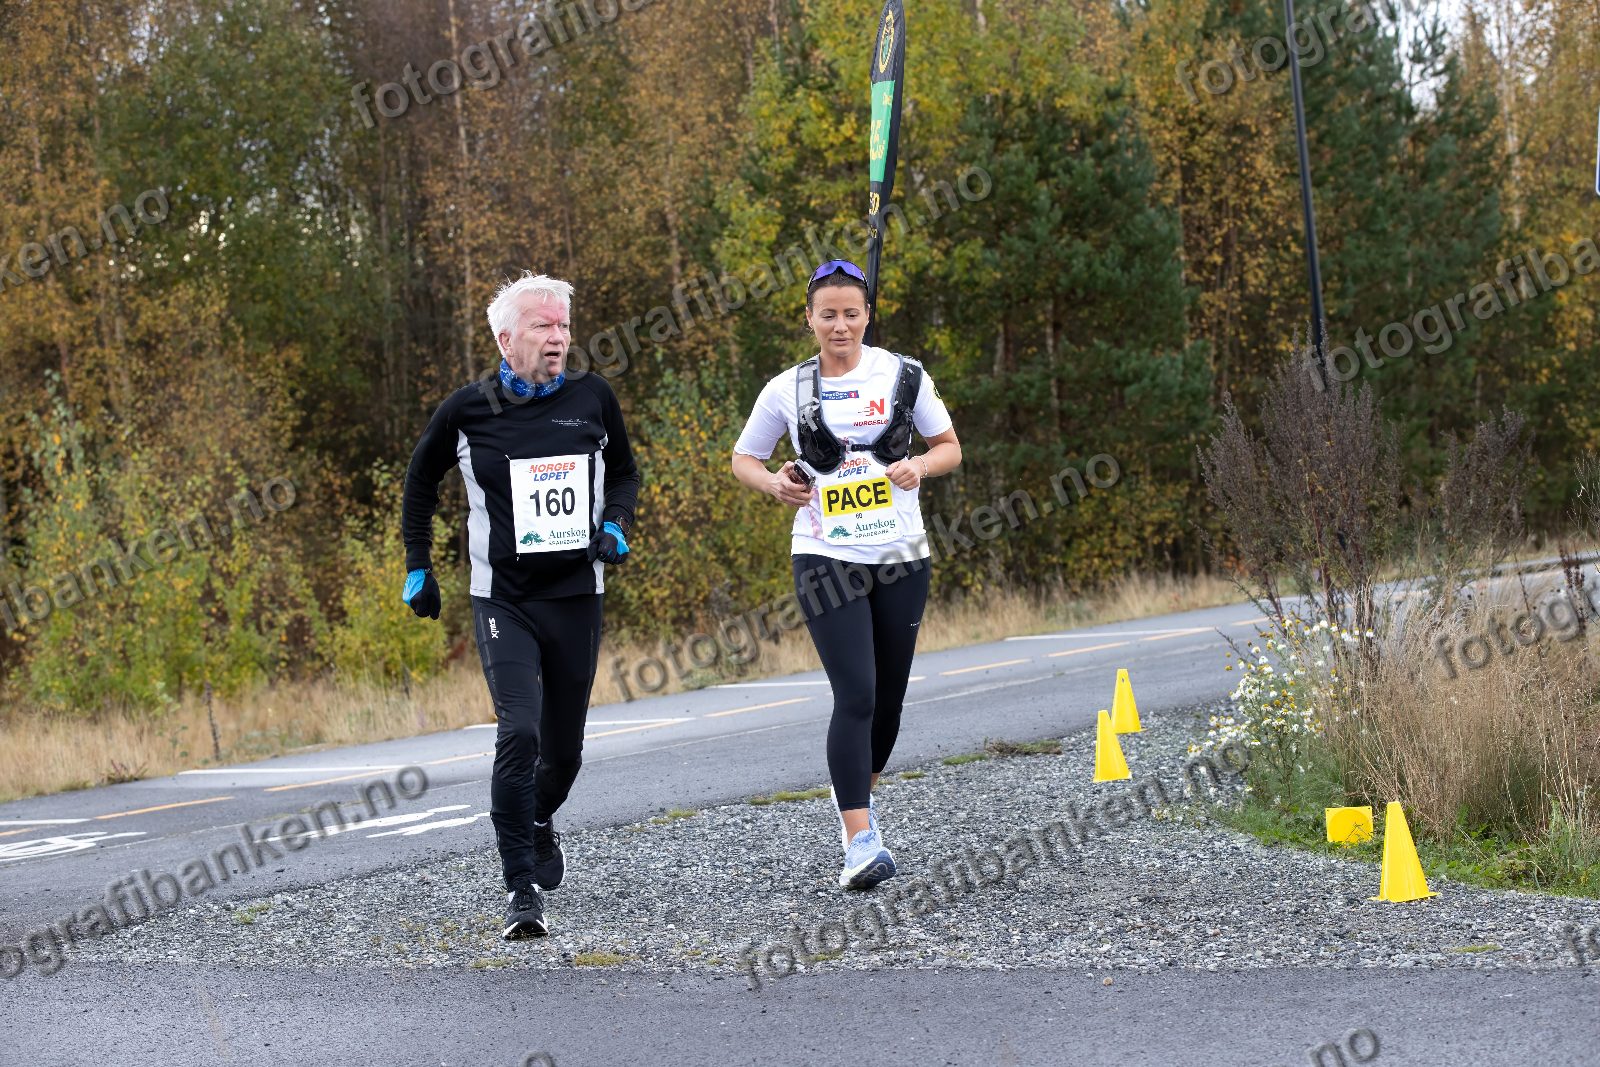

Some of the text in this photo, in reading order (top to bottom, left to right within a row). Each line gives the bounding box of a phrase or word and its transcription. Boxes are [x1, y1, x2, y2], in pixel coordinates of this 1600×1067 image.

[529, 462, 576, 474] NORGES
[837, 465, 869, 478] LØPET
[533, 471, 570, 482] LØPET
[529, 486, 576, 517] 160
[826, 481, 889, 512] PACE
[854, 518, 897, 533] Aurskog
[549, 527, 588, 539] Aurskog
